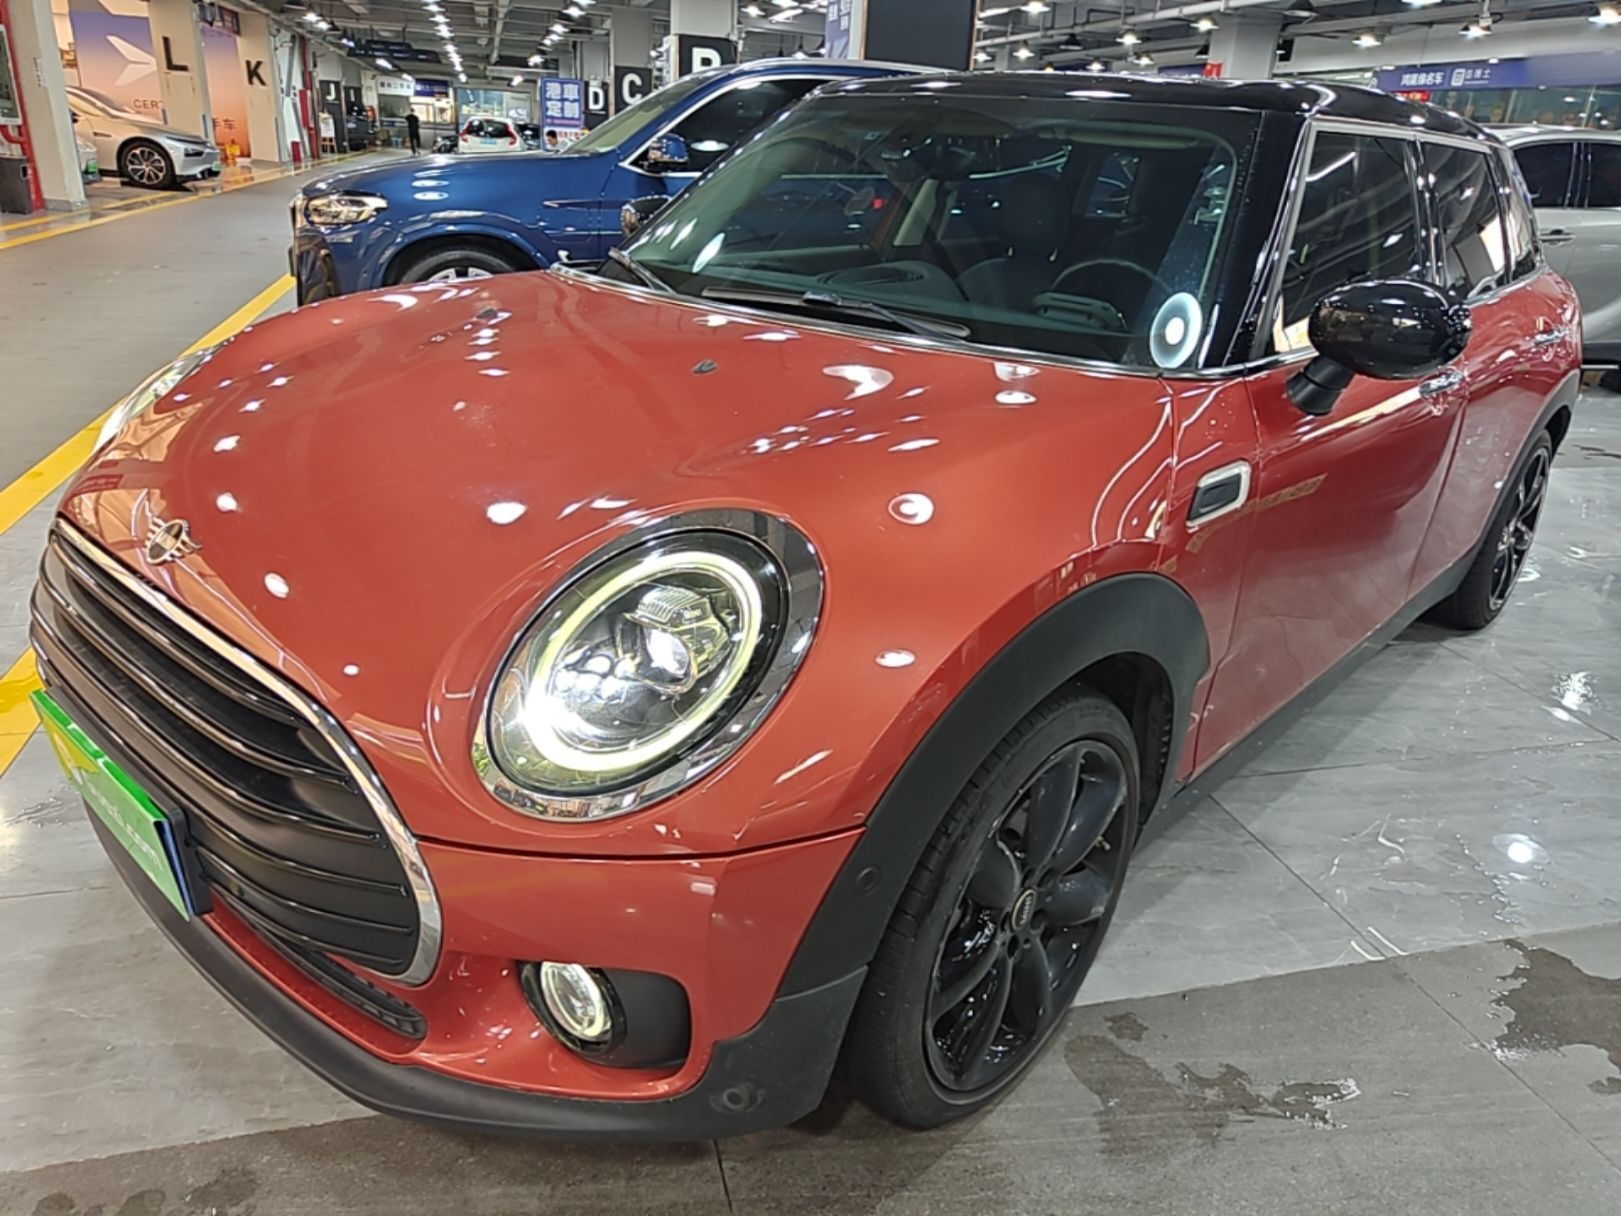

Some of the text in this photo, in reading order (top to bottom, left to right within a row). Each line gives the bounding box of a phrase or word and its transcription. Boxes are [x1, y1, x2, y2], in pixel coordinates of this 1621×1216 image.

[162, 36, 188, 72] L
[245, 60, 267, 86] K
[326, 83, 335, 100] J
[589, 86, 604, 110] D
[622, 73, 642, 105] C
